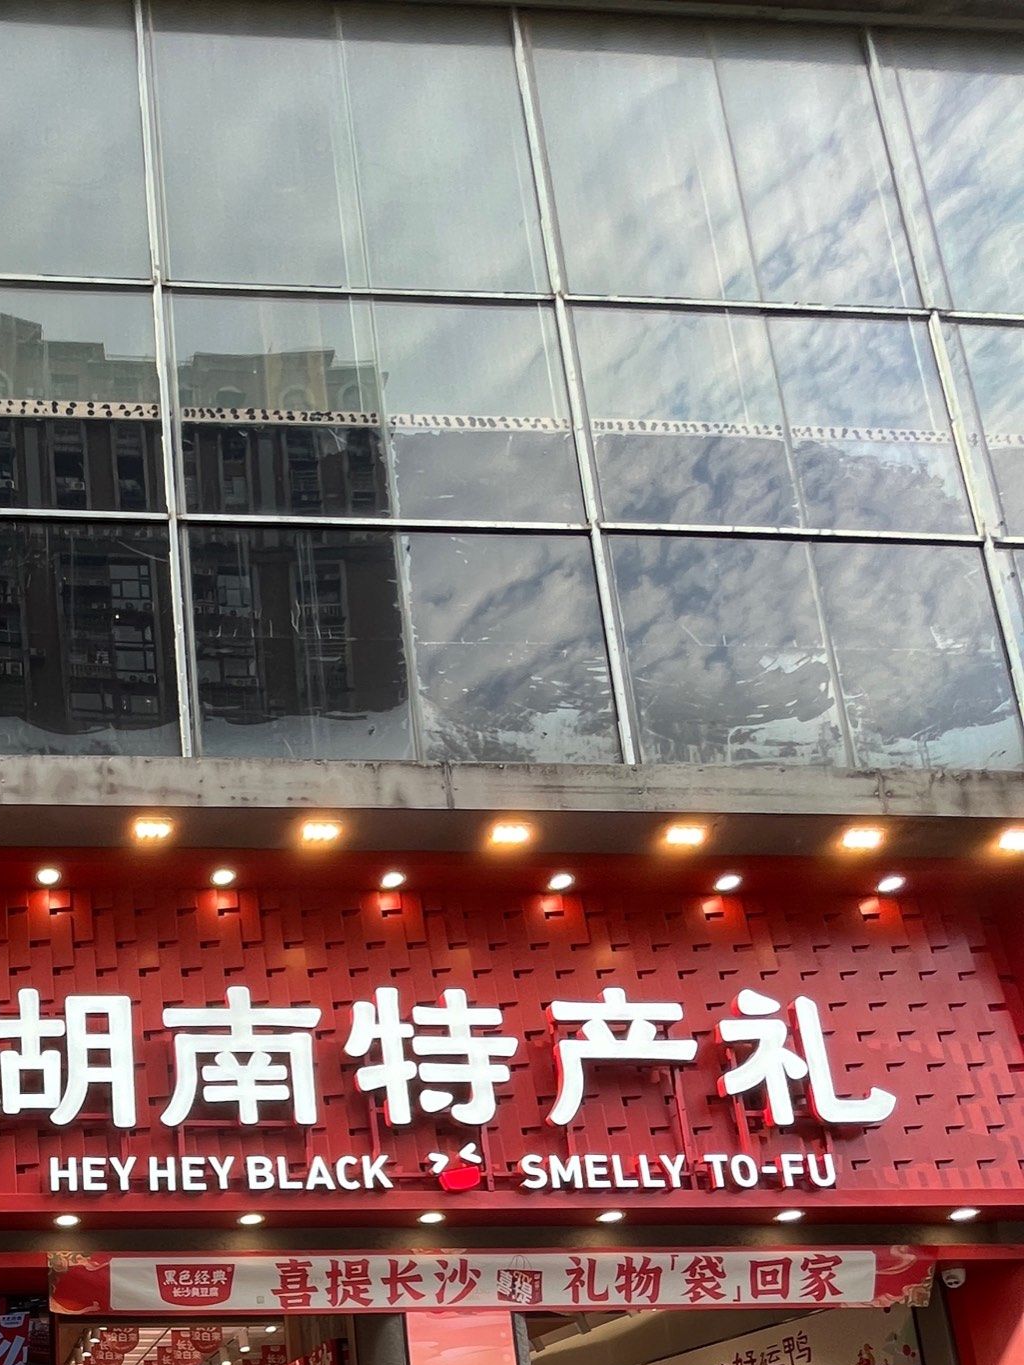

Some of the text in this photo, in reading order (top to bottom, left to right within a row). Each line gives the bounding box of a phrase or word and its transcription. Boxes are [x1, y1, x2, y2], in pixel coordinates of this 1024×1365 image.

[49, 1152, 838, 1192] HEY HEY BLACK SMELLY TO-FU
[162, 1268, 228, 1287] 黑色经典
[270, 1257, 482, 1309] 喜提长沙
